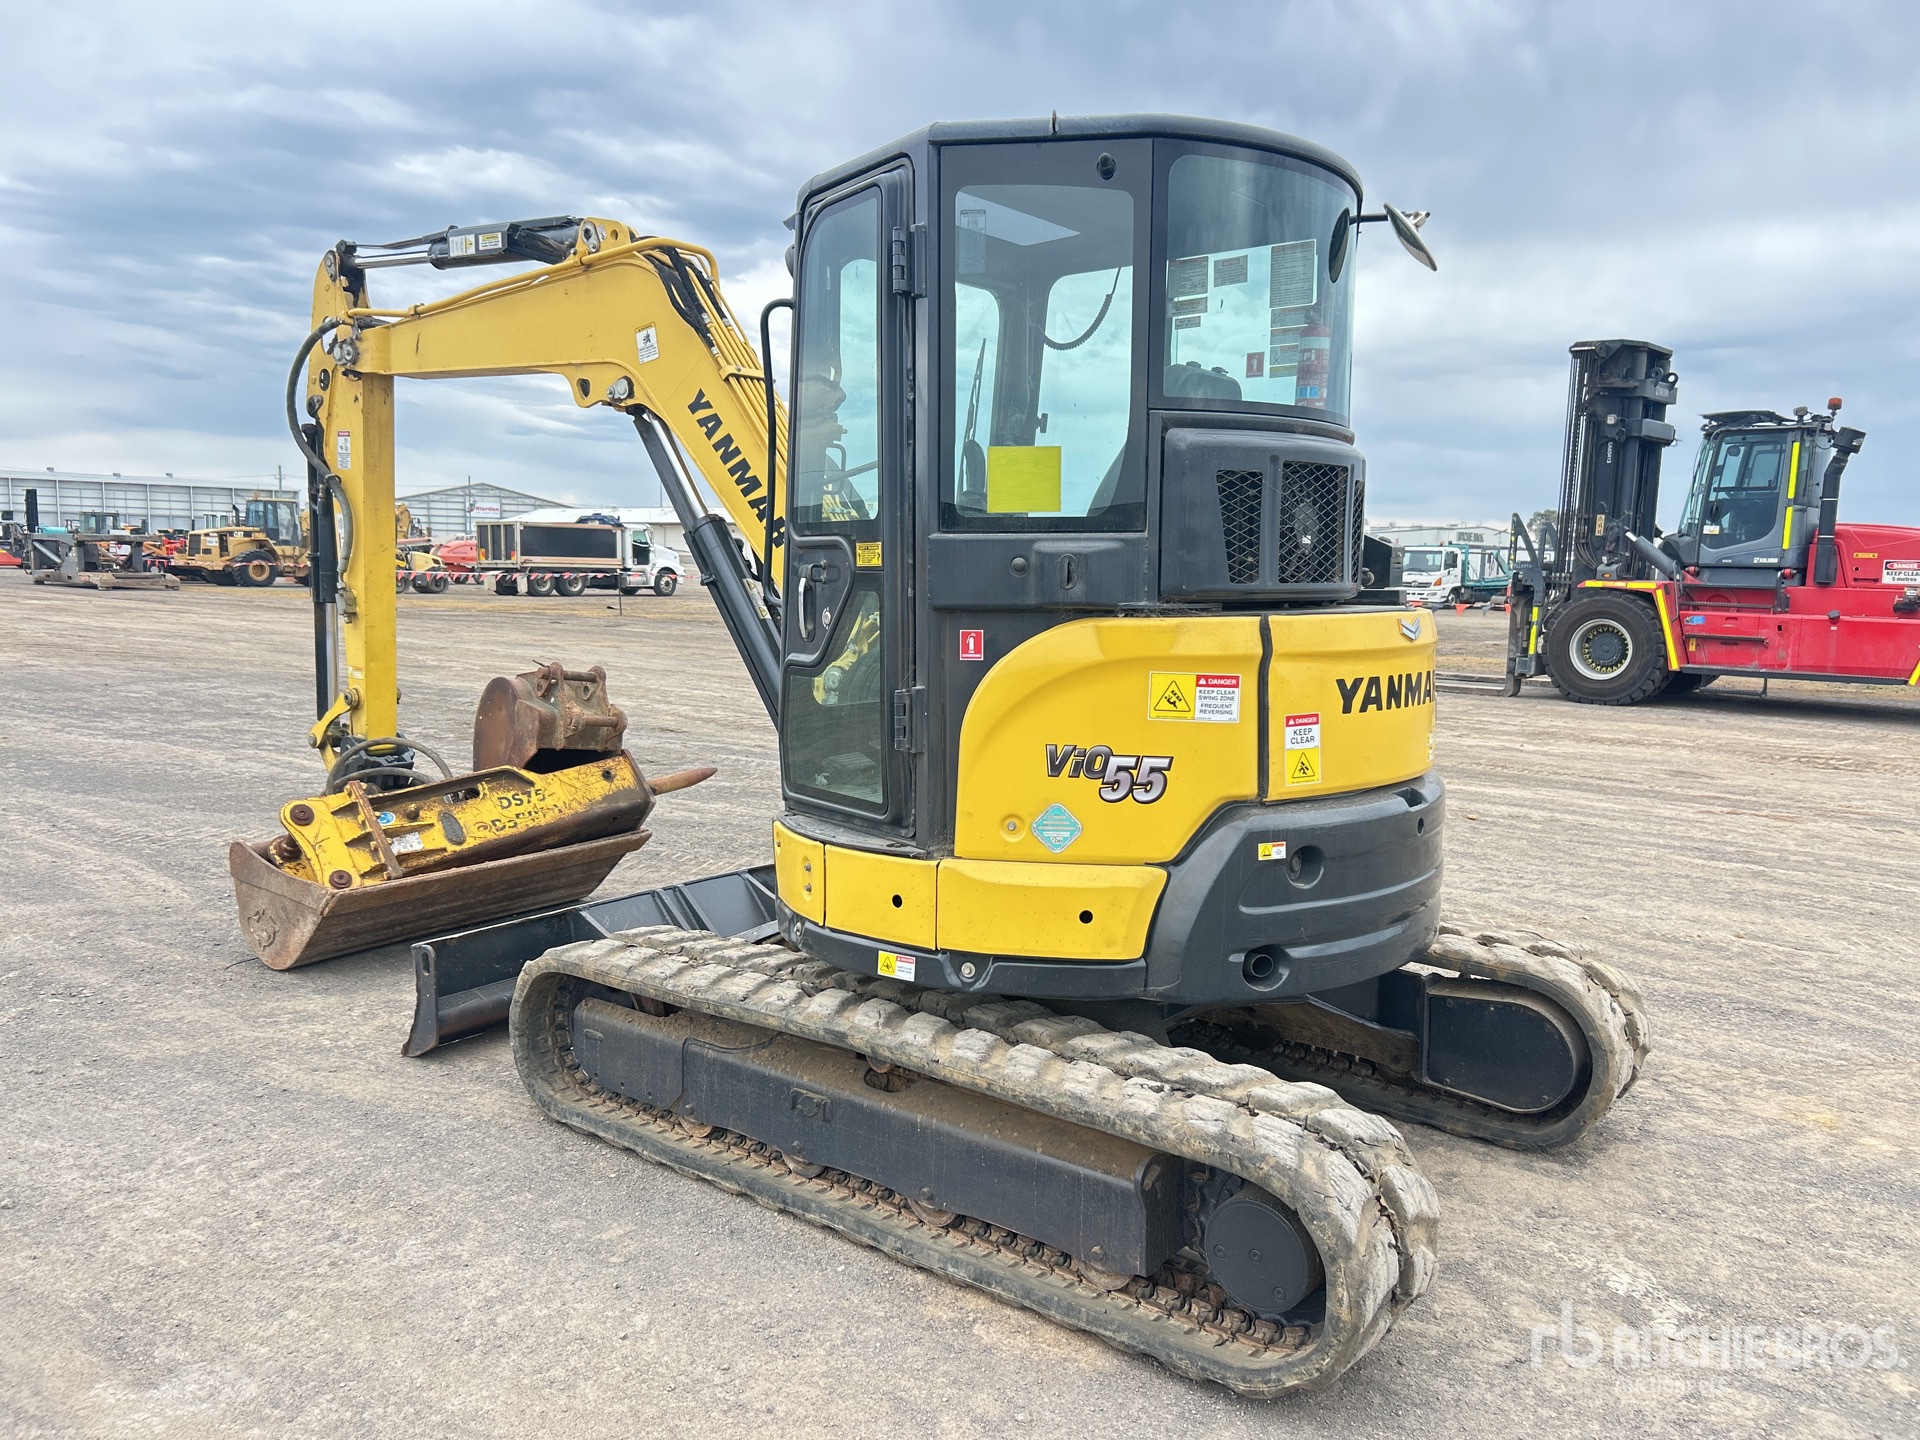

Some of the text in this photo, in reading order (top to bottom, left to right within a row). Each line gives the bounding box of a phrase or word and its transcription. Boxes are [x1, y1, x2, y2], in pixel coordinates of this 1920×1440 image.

[1335, 669, 1435, 715] YANMA
[1295, 716, 1318, 725] DANGER
[1293, 727, 1313, 737] KEEP
[1290, 735, 1315, 745] CLEAR
